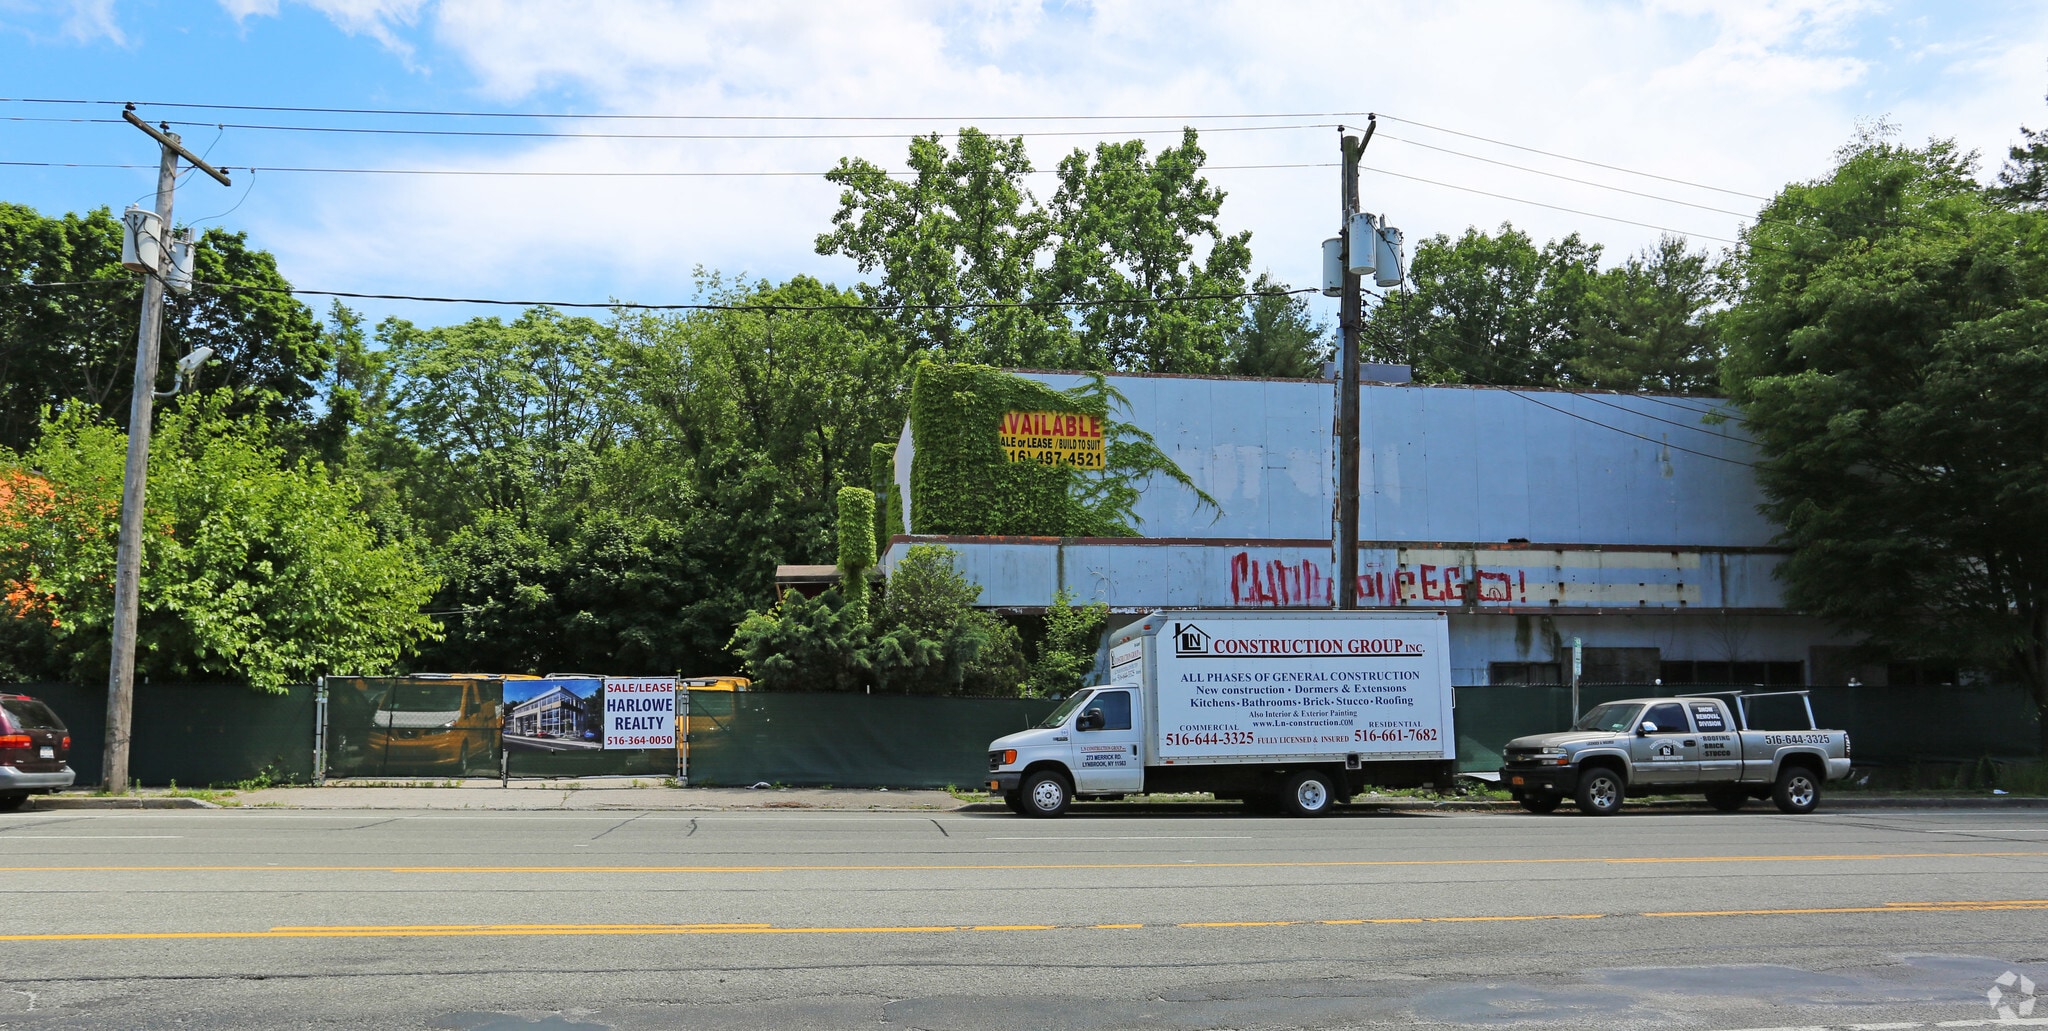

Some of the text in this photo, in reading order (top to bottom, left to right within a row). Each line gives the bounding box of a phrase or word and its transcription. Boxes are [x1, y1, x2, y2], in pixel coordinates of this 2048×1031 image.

[1000, 437, 1016, 447] ALE
[1018, 439, 1026, 447] or
[1027, 439, 1053, 449] LEASE
[1078, 440, 1086, 449] TO
[1087, 440, 1101, 450] SUIT
[1213, 639, 1343, 654] CONSTRUCTION
[1347, 639, 1403, 654] GROUP
[1405, 643, 1426, 653] INC.
[1180, 670, 1420, 682] ALL PHASES OF GENERAL CONSTRUCTION
[607, 683, 673, 693] SALE/LEASE
[1196, 684, 1407, 694] New construction Dormers & Extensions
[607, 698, 673, 712] HARLOWE
[1190, 696, 1414, 707] Kitchens Bathrooms Brick Stucco Roofing
[1330, 709, 1358, 717] Painting
[615, 716, 664, 730] REALTY
[607, 735, 673, 745] 516-364-0050
[1166, 732, 1254, 746] 516-644-3325
[1279, 736, 1311, 744] LICENSED
[1354, 728, 1438, 742] 516-661-7682
[1766, 735, 1829, 744] 516-644-3325
